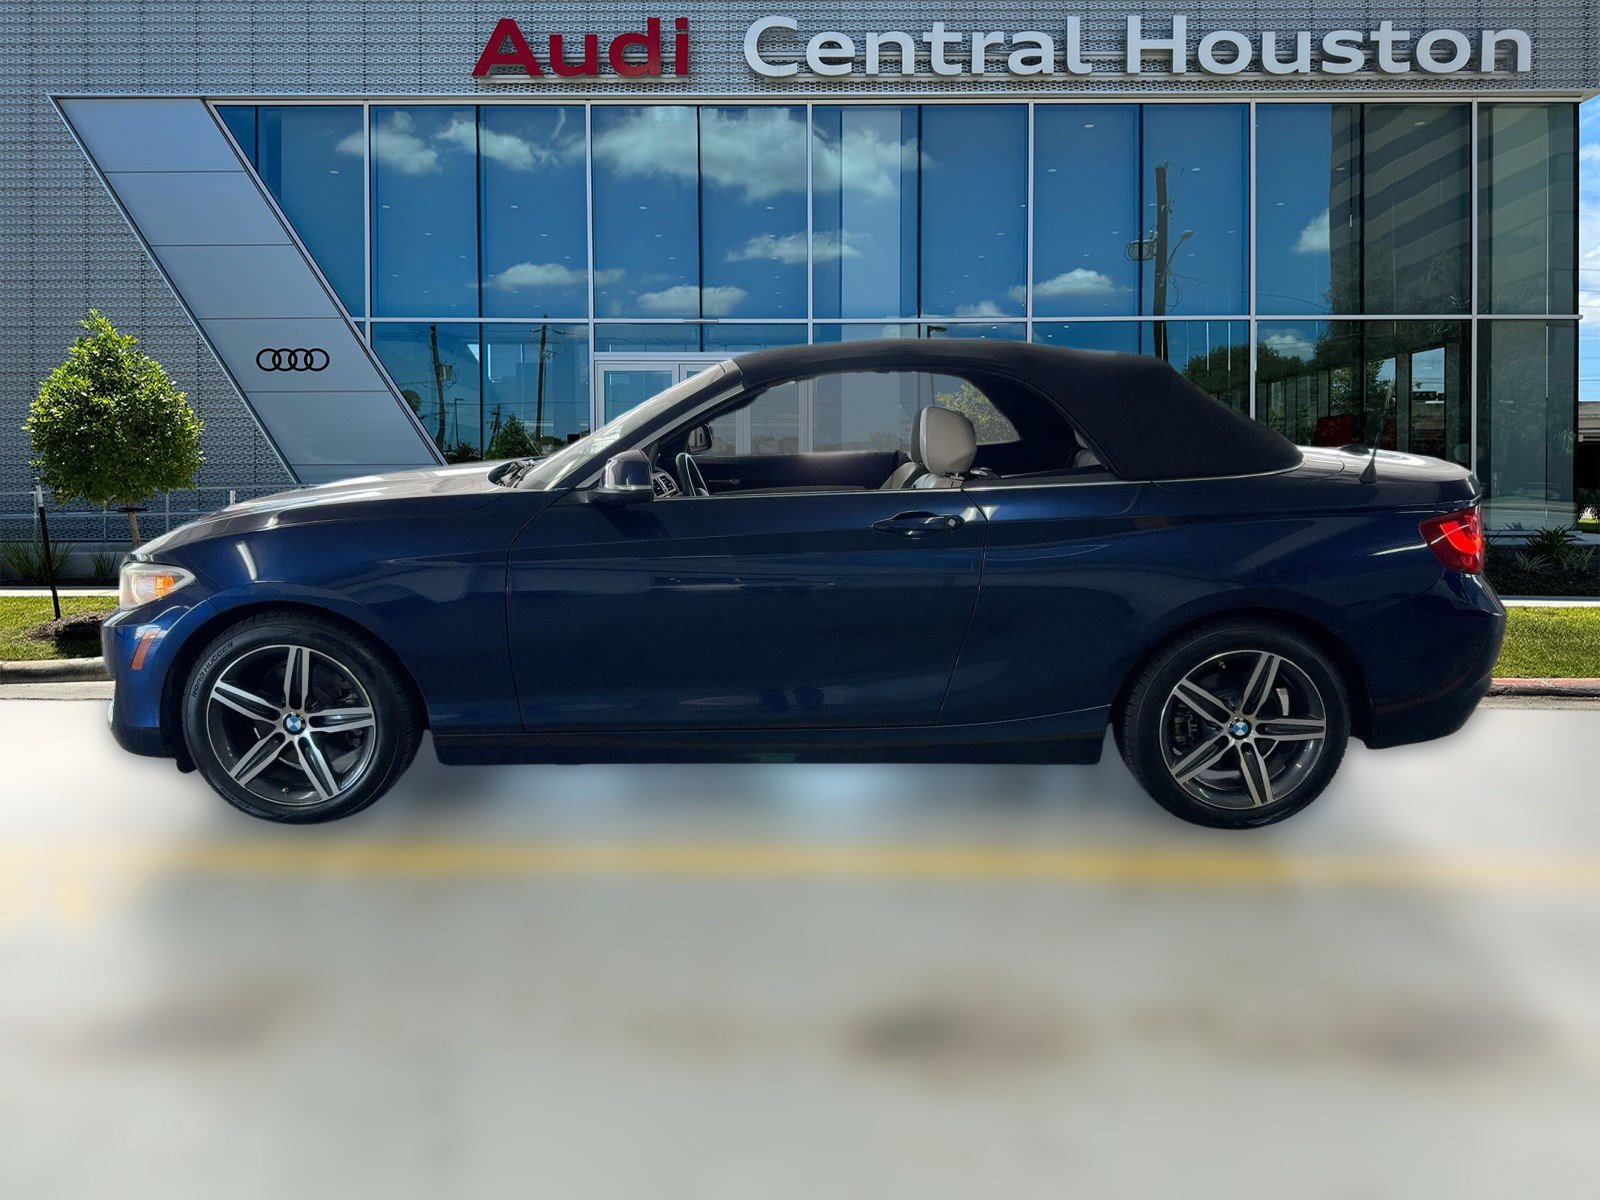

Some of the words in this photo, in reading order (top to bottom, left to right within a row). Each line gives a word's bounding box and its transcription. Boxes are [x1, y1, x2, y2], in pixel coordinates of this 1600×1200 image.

[471, 17, 689, 77] Audi
[743, 15, 1093, 77] Central
[1126, 15, 1532, 75] Houston
